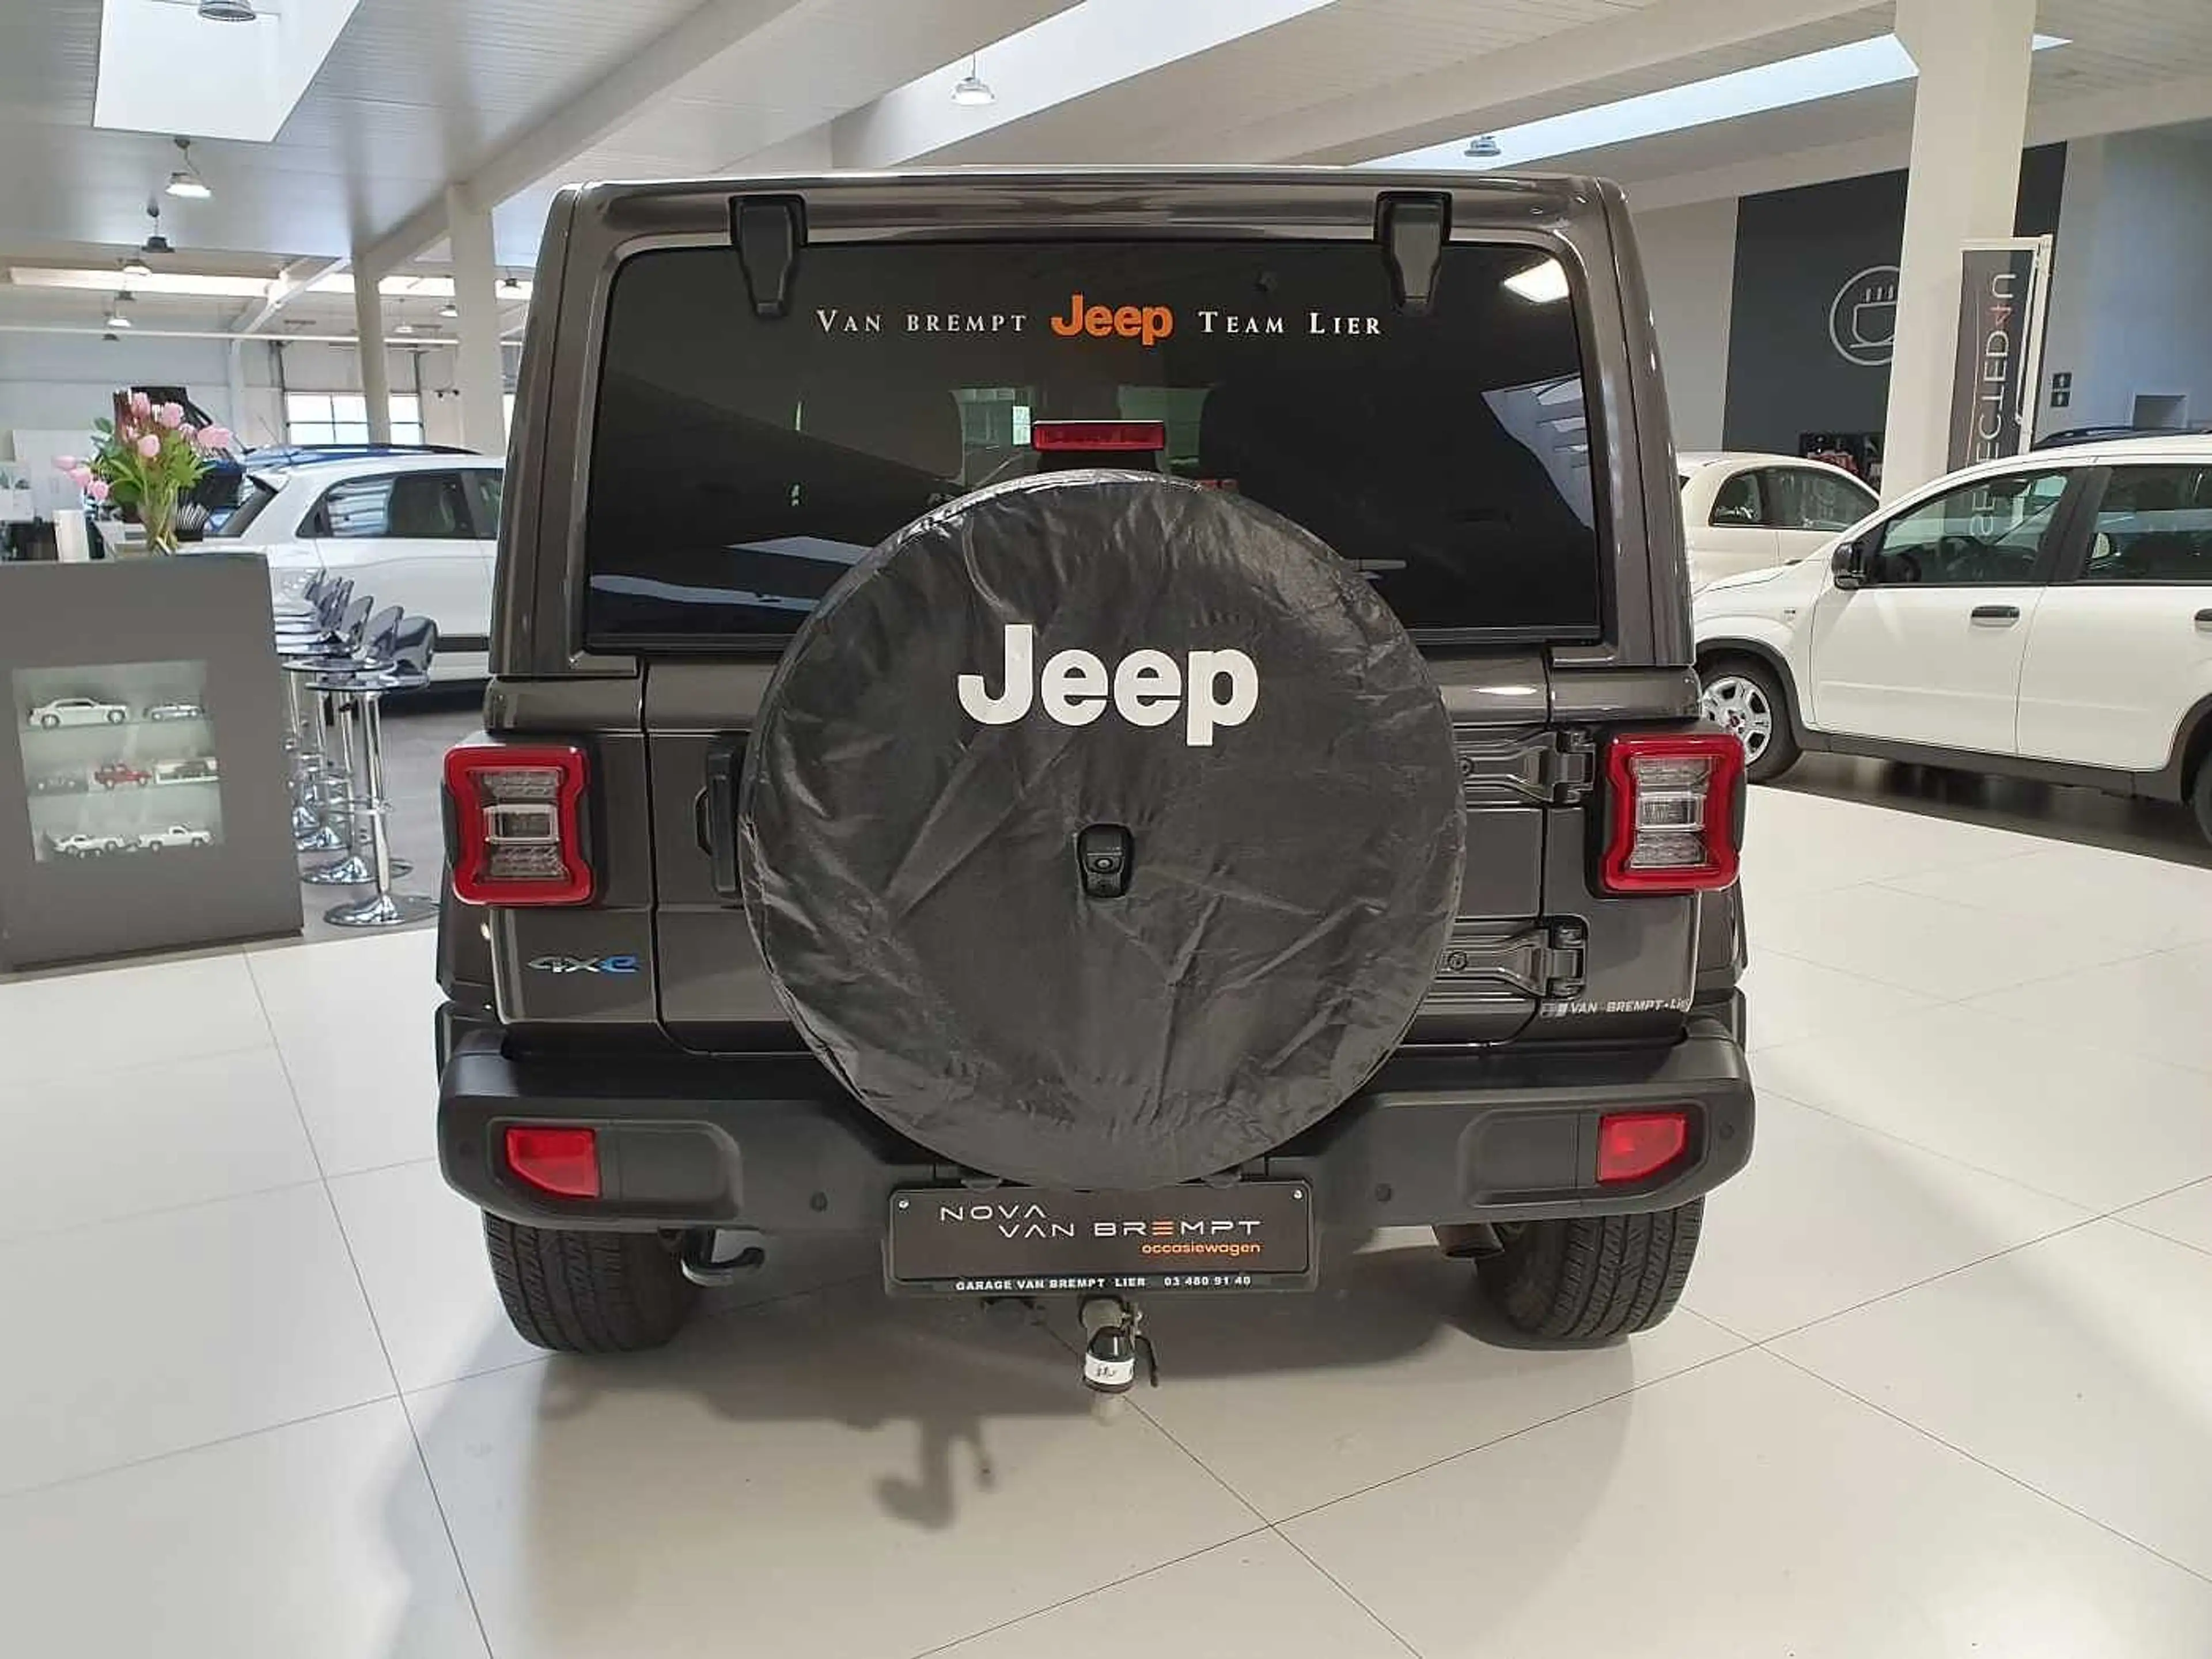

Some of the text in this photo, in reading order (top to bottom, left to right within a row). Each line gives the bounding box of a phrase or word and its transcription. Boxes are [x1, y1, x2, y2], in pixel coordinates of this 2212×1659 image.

[1050, 294, 1173, 345] Jeep
[958, 624, 1259, 747] Jeep
[1571, 1002, 1598, 1014] VAN
[940, 1205, 1046, 1221] NOVA
[998, 1221, 1261, 1238] VAN BREMPT
[1142, 1241, 1260, 1256] occasiewagen
[955, 1280, 1013, 1291] GARAGE
[1016, 1279, 1044, 1289] VAN
[1048, 1278, 1105, 1289] BREMPT
[1115, 1278, 1145, 1287] LIER
[1164, 1277, 1180, 1286] 03
